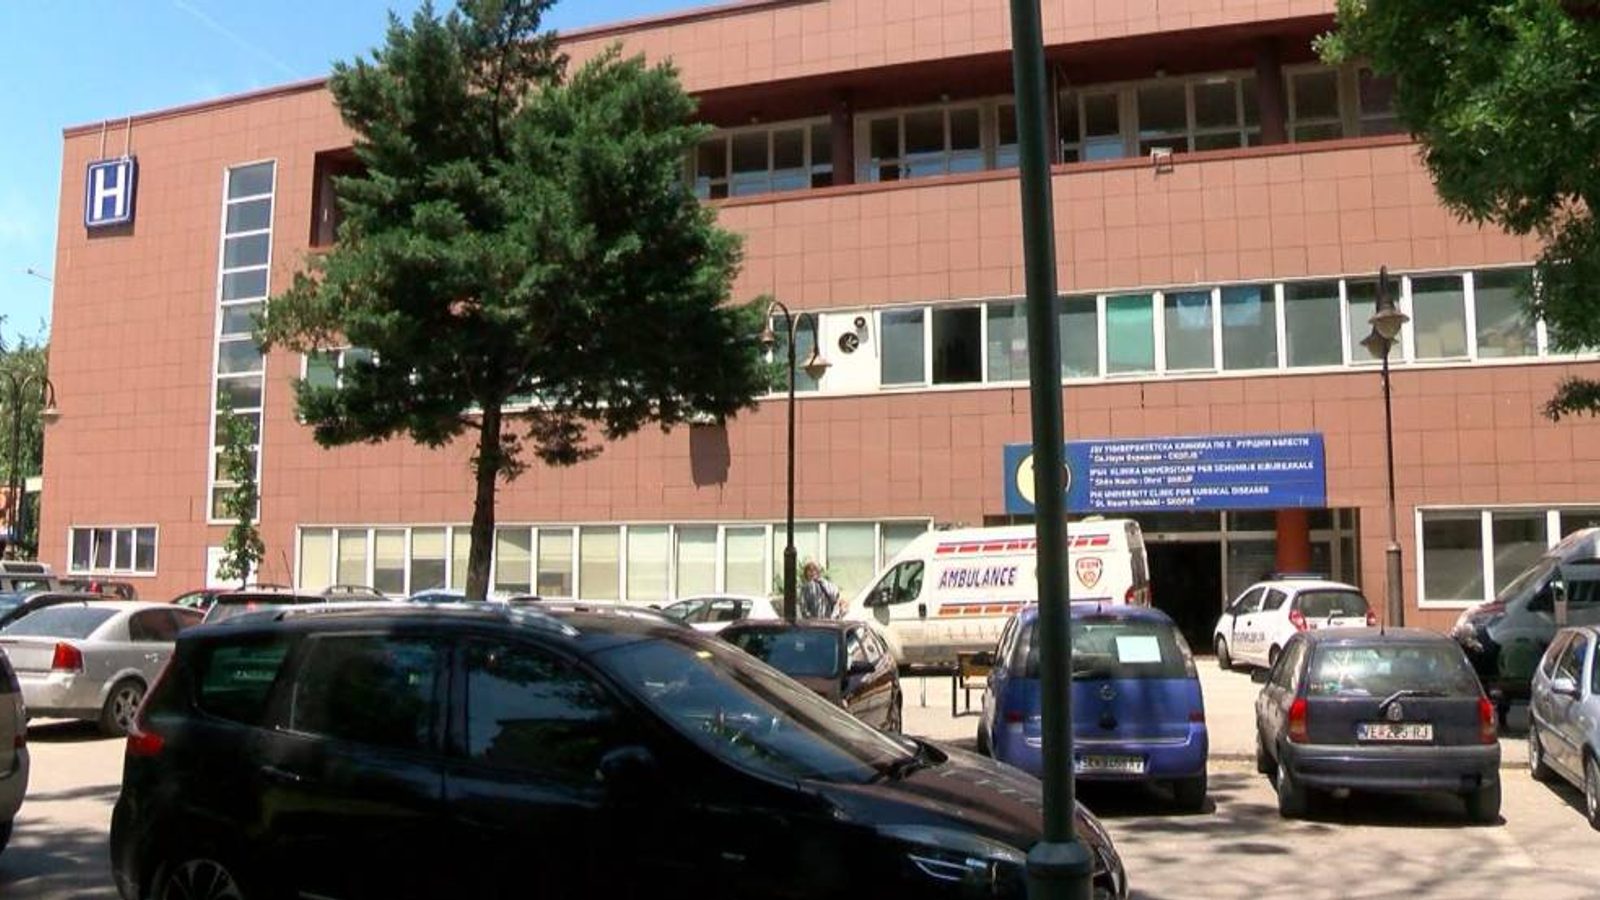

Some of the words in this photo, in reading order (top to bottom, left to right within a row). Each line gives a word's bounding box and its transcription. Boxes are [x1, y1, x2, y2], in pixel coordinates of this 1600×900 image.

[93, 165, 125, 220] H
[1110, 467, 1141, 476] KLINIKA
[1142, 465, 1196, 474] UNIVERSITARE
[1104, 489, 1148, 498] UNIVERSITY
[1149, 488, 1174, 497] CLINIC
[1175, 488, 1191, 497] FOR
[1192, 486, 1230, 496] SURGICAL
[1231, 485, 1270, 495] DISEASES
[938, 566, 1017, 589] AMBULANCE
